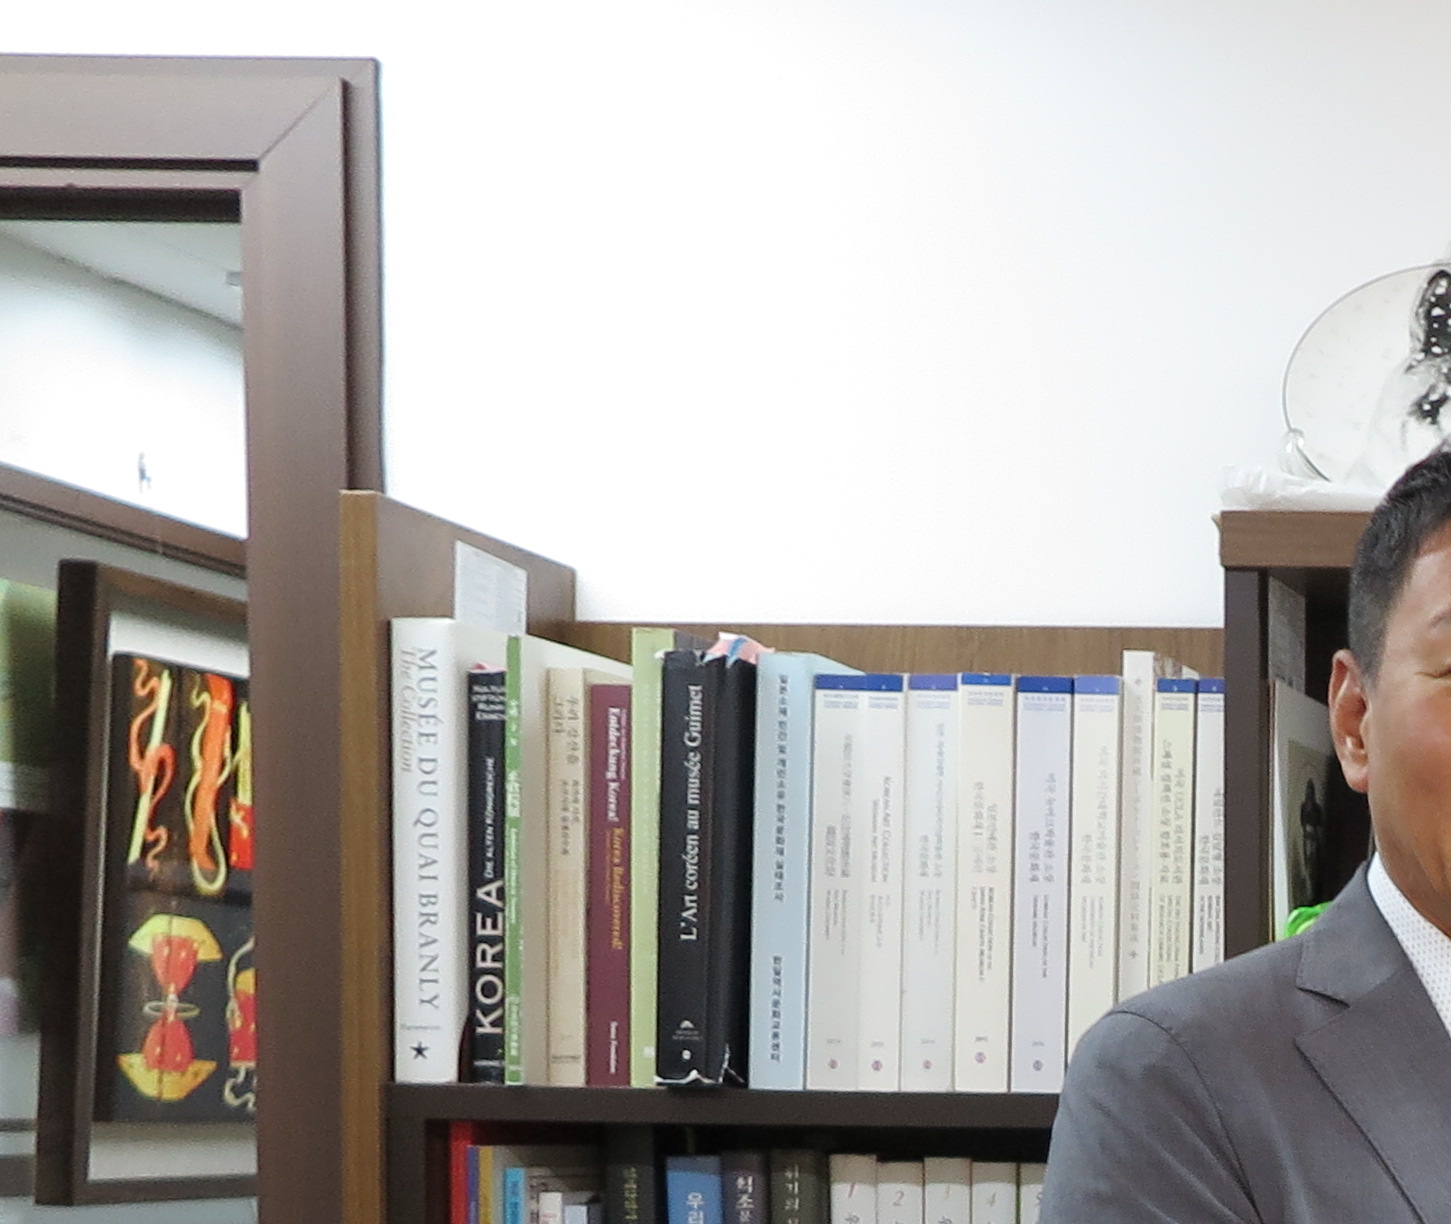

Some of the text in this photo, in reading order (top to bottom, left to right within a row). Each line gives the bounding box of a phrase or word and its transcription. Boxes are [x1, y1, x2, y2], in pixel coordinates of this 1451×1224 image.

[399, 684, 415, 774] Collection
[684, 684, 704, 747] Guimet
[411, 647, 441, 1011] MUSÉE DU QUAI BRANLY
[476, 879, 505, 1035] KOREA
